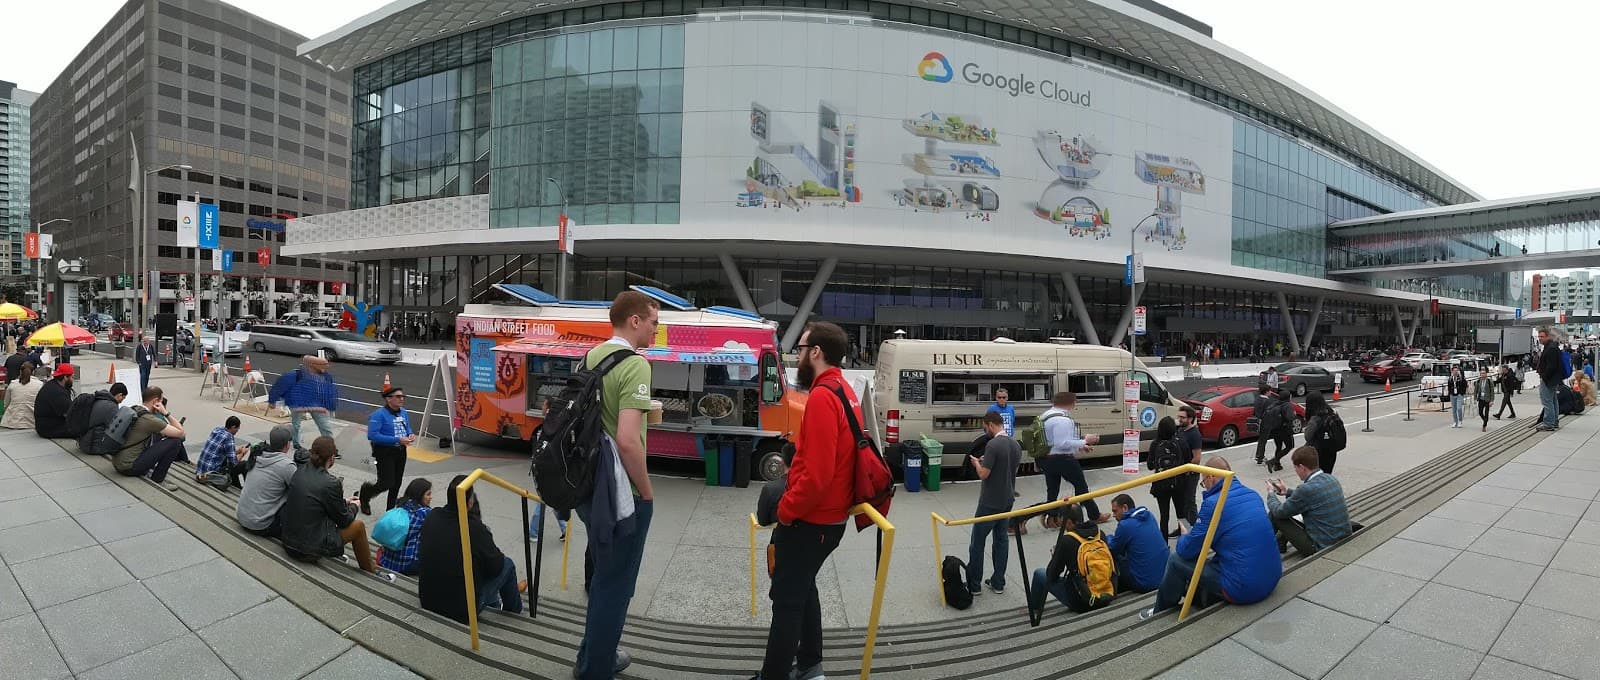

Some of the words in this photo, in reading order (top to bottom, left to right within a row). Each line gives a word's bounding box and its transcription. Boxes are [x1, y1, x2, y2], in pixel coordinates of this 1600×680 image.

[962, 62, 1035, 97] Google
[1039, 79, 1091, 108] Cloud
[205, 210, 213, 241] NEXT
[473, 320, 500, 333] INDIAN
[501, 321, 531, 335] STREET
[532, 322, 556, 336] FOOD
[933, 353, 951, 366] EL
[954, 353, 984, 366] SUR
